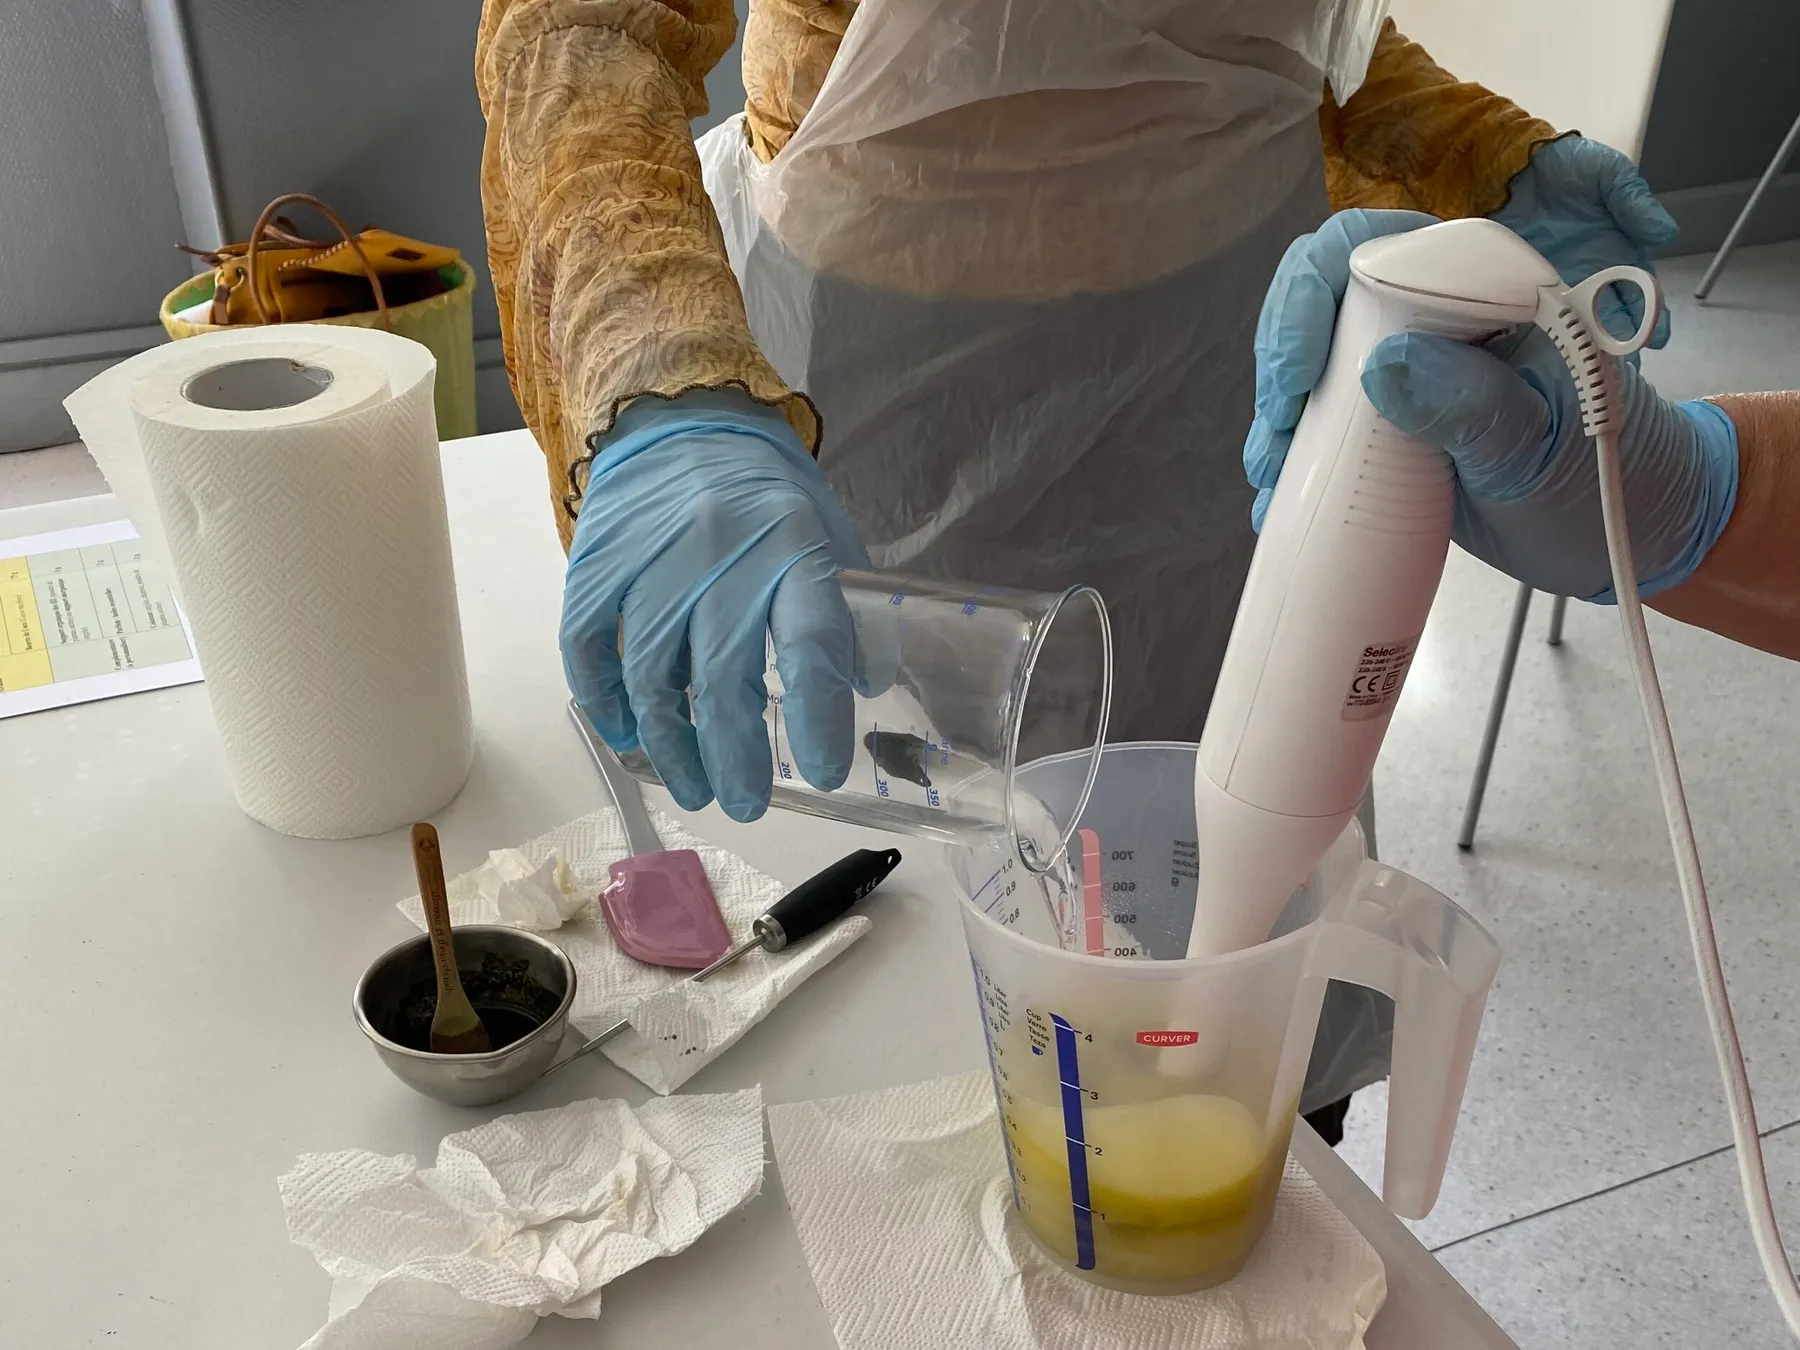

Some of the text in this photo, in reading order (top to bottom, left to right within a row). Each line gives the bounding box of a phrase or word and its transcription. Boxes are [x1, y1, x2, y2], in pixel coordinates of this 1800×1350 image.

[780, 761, 792, 780] 200
[878, 779, 889, 798] 300
[929, 788, 940, 807] 350
[1002, 858, 1013, 874] 1.0
[1005, 881, 1016, 896] 0.9
[1009, 908, 1020, 923] 0.8
[1026, 1008, 1042, 1021] Cup
[1026, 1017, 1047, 1032] Verre
[1028, 1025, 1050, 1042] Tasse
[1084, 1033, 1094, 1043] 4
[1142, 1033, 1192, 1043] CURVER
[1090, 1091, 1099, 1101] 3
[1094, 1146, 1103, 1156] 2
[1100, 1213, 1106, 1221] 1
